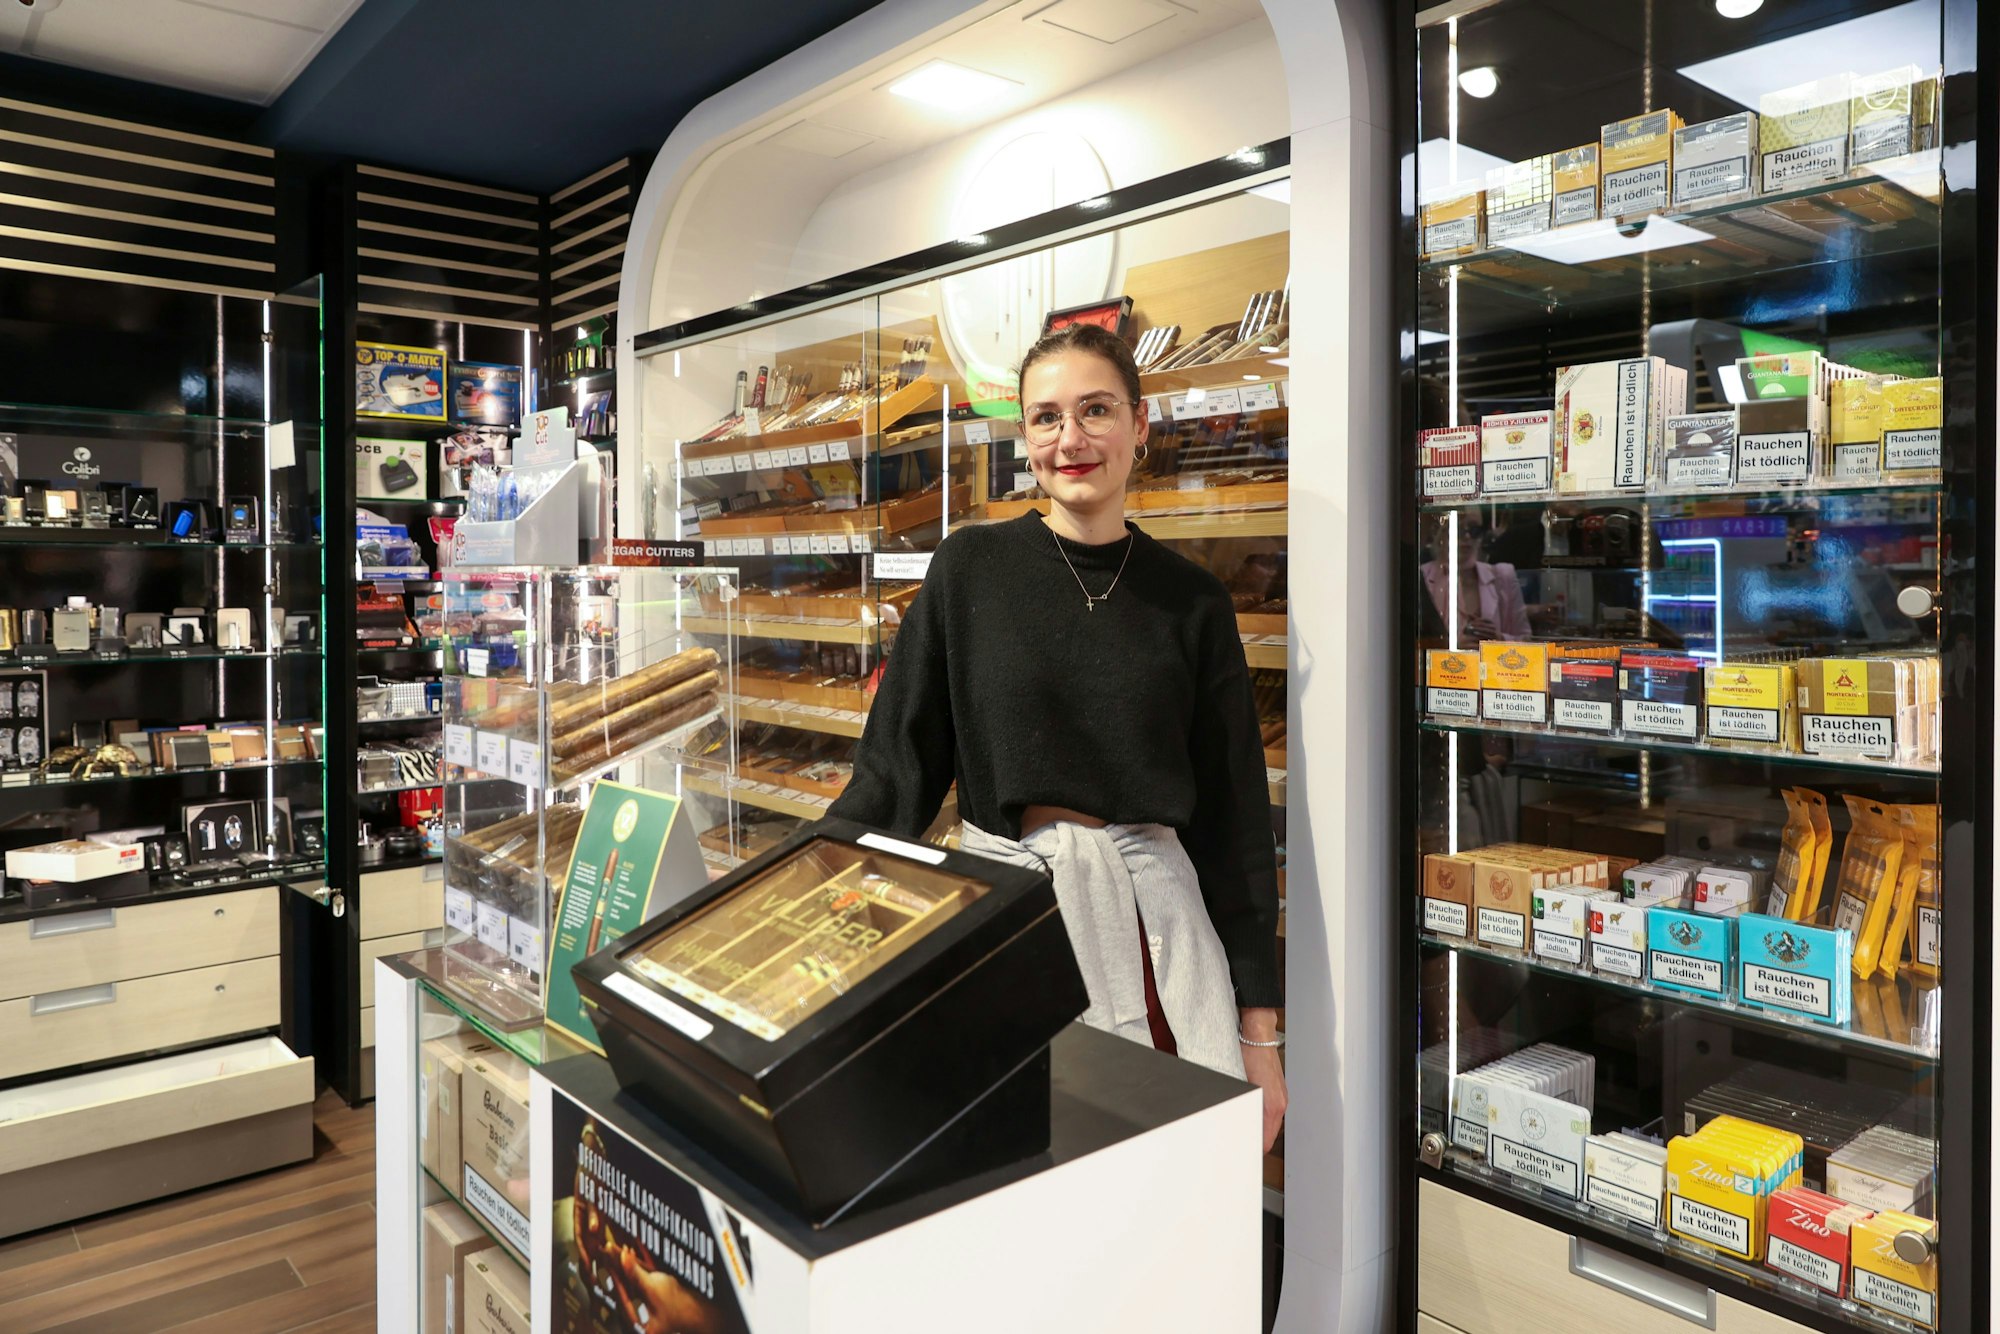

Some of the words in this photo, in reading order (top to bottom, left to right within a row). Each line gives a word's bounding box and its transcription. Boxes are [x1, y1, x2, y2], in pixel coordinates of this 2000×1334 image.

[1774, 143, 1833, 165] Rauchen
[1689, 163, 1731, 179] Rauchen
[1771, 167, 1787, 179] ist
[1791, 157, 1837, 174] tödlich
[1610, 169, 1661, 189] Rauchen
[1687, 180, 1698, 189] ist
[1559, 190, 1593, 204] Rauchen
[1607, 192, 1620, 205] ist
[1624, 184, 1664, 201] tödlich
[1434, 221, 1465, 235] Rauchen
[374, 350, 440, 367] TOP-O-MATIC
[1626, 363, 1637, 404] tödlich
[536, 414, 549, 431] TOP
[1486, 419, 1509, 428] ROMEO
[1515, 416, 1545, 426] JULIETA
[1624, 411, 1635, 425] ist
[1668, 416, 1733, 429] GUANTANAMERA
[535, 431, 548, 445] Cut
[1744, 438, 1803, 451] Rauchen
[1891, 433, 1937, 443] Rauchen
[1623, 430, 1634, 484] Rauchen
[1841, 446, 1878, 455] Rauche
[1888, 448, 1898, 457] ist
[1900, 446, 1938, 457] tödlich
[1496, 461, 1534, 471] Rauchen
[1679, 457, 1720, 467] Rauchen
[1740, 456, 1757, 467] ist
[1760, 455, 1806, 467] tödlich
[1856, 456, 1868, 464] ist
[62, 461, 100, 476] Colibri
[1429, 467, 1470, 479] Rauchen
[1677, 468, 1688, 476] ist
[1426, 480, 1440, 489] ist
[1443, 477, 1473, 488] tödlich
[1493, 473, 1504, 481] ist
[1506, 471, 1536, 481] tödlich
[645, 546, 695, 558] CUTTERS
[1437, 690, 1468, 699] Rauchen
[1495, 691, 1533, 702] Rauchen
[1722, 686, 1763, 694] MONTECRISTO
[1435, 698, 1447, 706] ist
[1448, 698, 1470, 708] tödlich
[1493, 702, 1505, 711] ist
[1507, 702, 1535, 712] tödlich
[1564, 701, 1601, 710] Rauchen
[1636, 702, 1682, 714] Rauchen
[1562, 710, 1573, 718] ist
[1575, 710, 1603, 720] tödlich
[1634, 713, 1647, 722] ist
[1649, 714, 1685, 725] tödlich
[1722, 709, 1764, 720] Rauchen
[1719, 719, 1731, 728] ist
[1733, 720, 1767, 730] tödlich
[1811, 717, 1881, 732] Rauchen
[1807, 730, 1826, 742] ist
[1831, 731, 1887, 746] tödlich
[1428, 902, 1463, 916] Rauchen
[759, 894, 884, 949] VILLIGER
[1426, 911, 1437, 919] ist
[1438, 913, 1465, 926] tödlich
[1481, 912, 1519, 926] Rauchen
[1480, 921, 1491, 930] ist
[1492, 924, 1522, 937] tödlich
[1538, 933, 1567, 945] Rauchen
[1546, 943, 1569, 953] tödlich
[1596, 946, 1626, 958] Rauchen
[1628, 953, 1637, 961] ist
[1605, 956, 1629, 967] tödlich
[1655, 953, 1703, 970] Rauchen
[1704, 963, 1718, 973] ist
[1668, 967, 1705, 981] tödlich
[1757, 970, 1815, 990] Rauchen
[1754, 981, 1770, 993] ist
[1774, 984, 1819, 1005] tödlich
[1460, 1121, 1488, 1137] Rauche
[1469, 1135, 1487, 1147] tödli
[1504, 1143, 1549, 1167] Rauchen
[1552, 1158, 1565, 1173] ist
[1516, 1158, 1551, 1180] tödlich
[1687, 1159, 1734, 1187] Zino
[469, 1175, 497, 1211] Rauchen
[1590, 1182, 1620, 1199] Rauchen
[1621, 1193, 1630, 1202] ist
[1631, 1198, 1655, 1212] tödlich
[578, 1142, 627, 1199] OFFIZIELLE
[630, 1180, 714, 1266] KLASSIFIKATION
[1682, 1200, 1737, 1227] Rauchen
[1679, 1213, 1694, 1227] ist
[1697, 1218, 1740, 1243] tödlich
[1785, 1208, 1831, 1237] Zino
[578, 1172, 596, 1204] DER
[598, 1186, 638, 1238] STÄRKEN
[640, 1219, 661, 1256] VON
[663, 1237, 714, 1299] HABANOS
[1781, 1242, 1827, 1270] Rauchen
[1778, 1253, 1791, 1266] ist
[1793, 1257, 1829, 1282] tödlich
[1867, 1275, 1918, 1301] Rauchen
[1865, 1285, 1878, 1297] ist
[1880, 1289, 1921, 1313] tödlich
